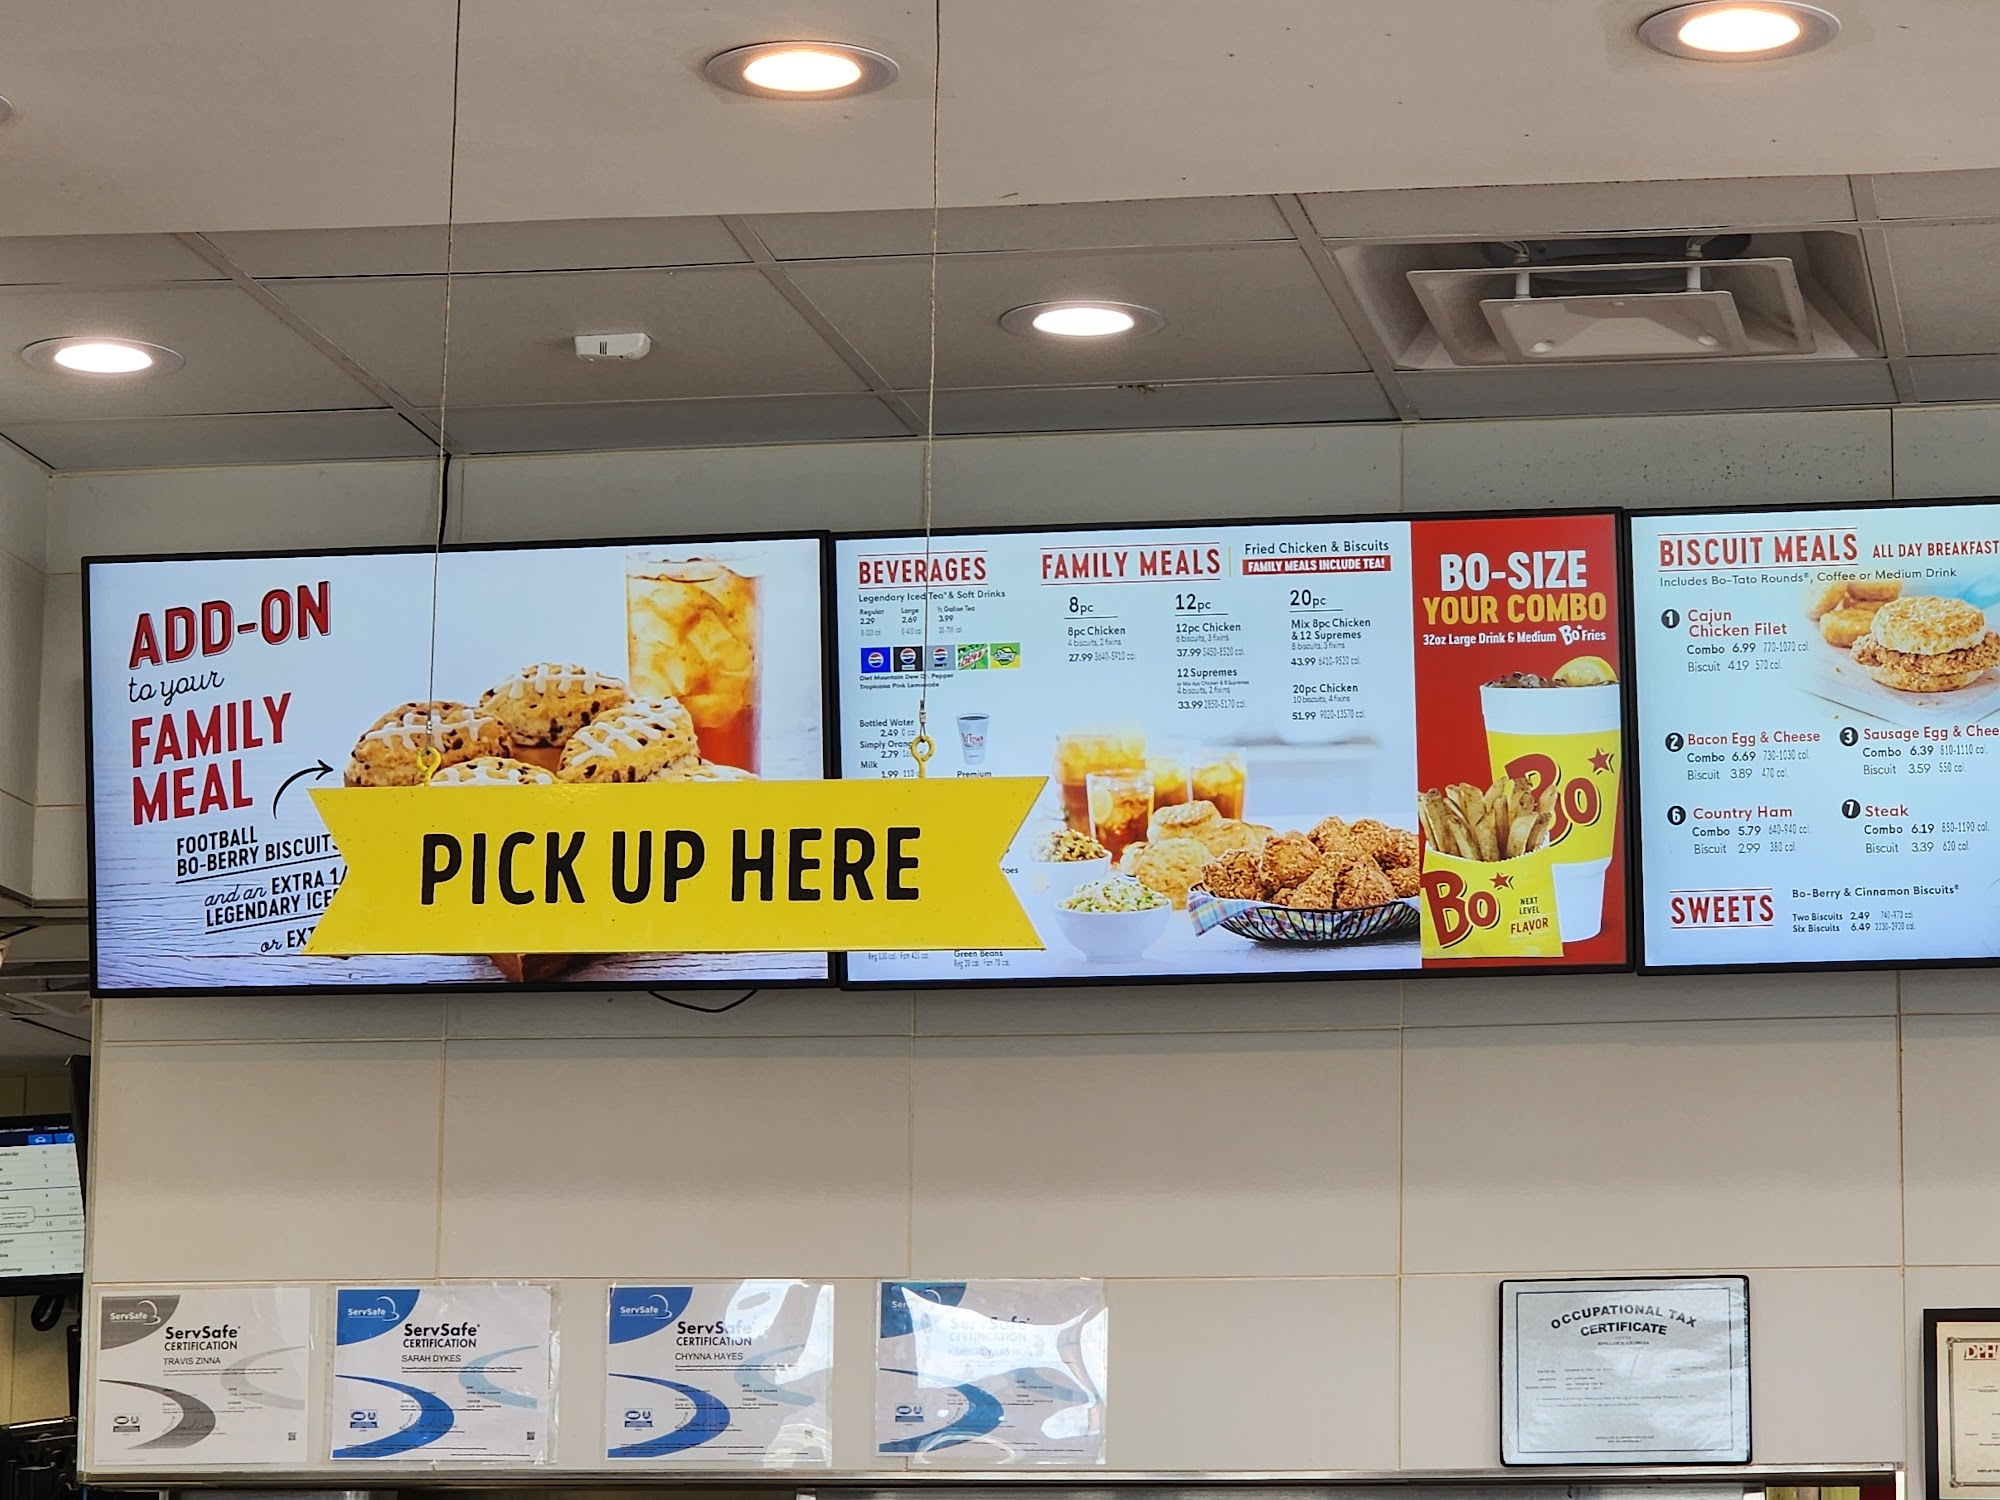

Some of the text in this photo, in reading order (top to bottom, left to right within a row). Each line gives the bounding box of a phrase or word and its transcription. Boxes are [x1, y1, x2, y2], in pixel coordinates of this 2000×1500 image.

[1245, 539, 1389, 555] Fried Chicken & Biscuits
[1660, 533, 2000, 567] BISCUIT MEALS ALL DAY BREAKFAST
[1042, 548, 1221, 579] FAMILY MEALS
[1248, 557, 1385, 573] FAMILY MEALS INCLUDE TEA!
[859, 556, 987, 585] BEVERAGES
[1440, 550, 1587, 592] BO-SIZE
[1660, 575, 1708, 587] Includes
[1711, 574, 1757, 586] Bo-Tato
[1817, 570, 1856, 582] Coffee
[1859, 573, 1871, 581] or
[1875, 568, 1922, 580] Medium
[1926, 567, 1957, 578] Drink
[858, 593, 905, 604] Legendary
[907, 592, 927, 601] Iced
[957, 590, 975, 599] Soft
[978, 590, 1005, 598] Drinks
[1176, 593, 1211, 612] 12pc
[1290, 589, 1326, 609] 20pc
[1068, 597, 1094, 616] 8pc
[1423, 592, 1607, 625] YOUR COMBO
[1291, 617, 1371, 630] Mix 8pc Chicken
[1688, 609, 1732, 625] Cajun
[129, 580, 332, 670] ADD-ON
[1067, 625, 1126, 638] 8pc Chicken
[1176, 622, 1241, 635] 12pc Chicken
[1689, 622, 1787, 637] Chicken Filet
[1291, 630, 1362, 642] & 12 Supremes
[1423, 633, 1446, 646] 32oz
[1448, 633, 1476, 647] Large
[1478, 632, 1506, 644] Drink
[1507, 632, 1515, 643] &
[1517, 630, 1556, 643] Medium
[1582, 629, 1606, 641] Fries
[1176, 648, 1201, 657] 37.99
[1686, 642, 1756, 655] Combo 6.99
[1068, 653, 1093, 662] 27.99
[1177, 667, 1238, 679] 12 Supremes
[1688, 661, 1721, 672] Biscuit
[129, 670, 225, 706] to your
[1292, 683, 1358, 696] 20pc Chicken
[1178, 700, 1203, 709] 33.99
[860, 719, 914, 728] Bottled Water
[131, 692, 292, 769] FAMILY
[880, 729, 898, 737] 2.49
[1864, 728, 1920, 743] Sausage
[1923, 726, 1948, 741] Egg
[1952, 725, 1962, 737] &
[1688, 733, 1728, 746] Bacon
[1732, 732, 1756, 747] Egg
[1760, 731, 1769, 743] &
[1773, 730, 1821, 743] Cheese
[1687, 751, 1756, 763] Combo 6.69
[1862, 745, 1934, 758] Combo 6.39
[1687, 768, 1753, 780] Biscuit 3.89
[1863, 763, 1931, 775] Biscuit 3.59
[132, 758, 253, 826] MEAL
[1693, 807, 1752, 822] Country
[1757, 805, 1793, 818] Ham
[1865, 804, 1909, 817] Steak
[1692, 825, 1762, 837] Combo 5.79
[1864, 823, 1935, 835] Combo 6.19
[177, 825, 258, 856] FOOTBALL
[1694, 842, 1761, 854] Biscuit 2.99
[1865, 841, 1934, 854] Biscuit 3.39
[177, 833, 340, 877] BO-BERRY BISCUIT
[421, 827, 921, 905] PICK UP HERE
[204, 869, 325, 907] and an EXTRA
[1792, 888, 1841, 900] Bo-Berry
[1844, 887, 1851, 897] &
[1854, 886, 1910, 897] Cinnamon
[1520, 896, 1538, 907] NEXT
[205, 896, 299, 927] LEGENDARY
[1519, 905, 1540, 915] LEVEL
[1670, 894, 1774, 925] SWEETS
[1792, 911, 1870, 921] Two Biscuits 2.49
[1510, 918, 1549, 935] FLAVOR
[1792, 922, 1871, 932] Six Biscuits 6.49
[110, 1311, 148, 1321] ServSafe
[348, 1307, 386, 1317] ServSafe
[620, 1305, 659, 1315] ServSafe
[1550, 1304, 1698, 1329] OCCUPATIONAL TAX
[1580, 1321, 1668, 1336] CERTIFICATE
[164, 1340, 238, 1352] CERTIFICATION
[403, 1338, 477, 1349] CERTIFICATION
[676, 1336, 752, 1347] CERTIFICATION
[163, 1356, 221, 1366] TRAVIS ZINNA
[401, 1353, 462, 1363] SARAH DYKES
[675, 1351, 744, 1361] CHYNNA HAYES
